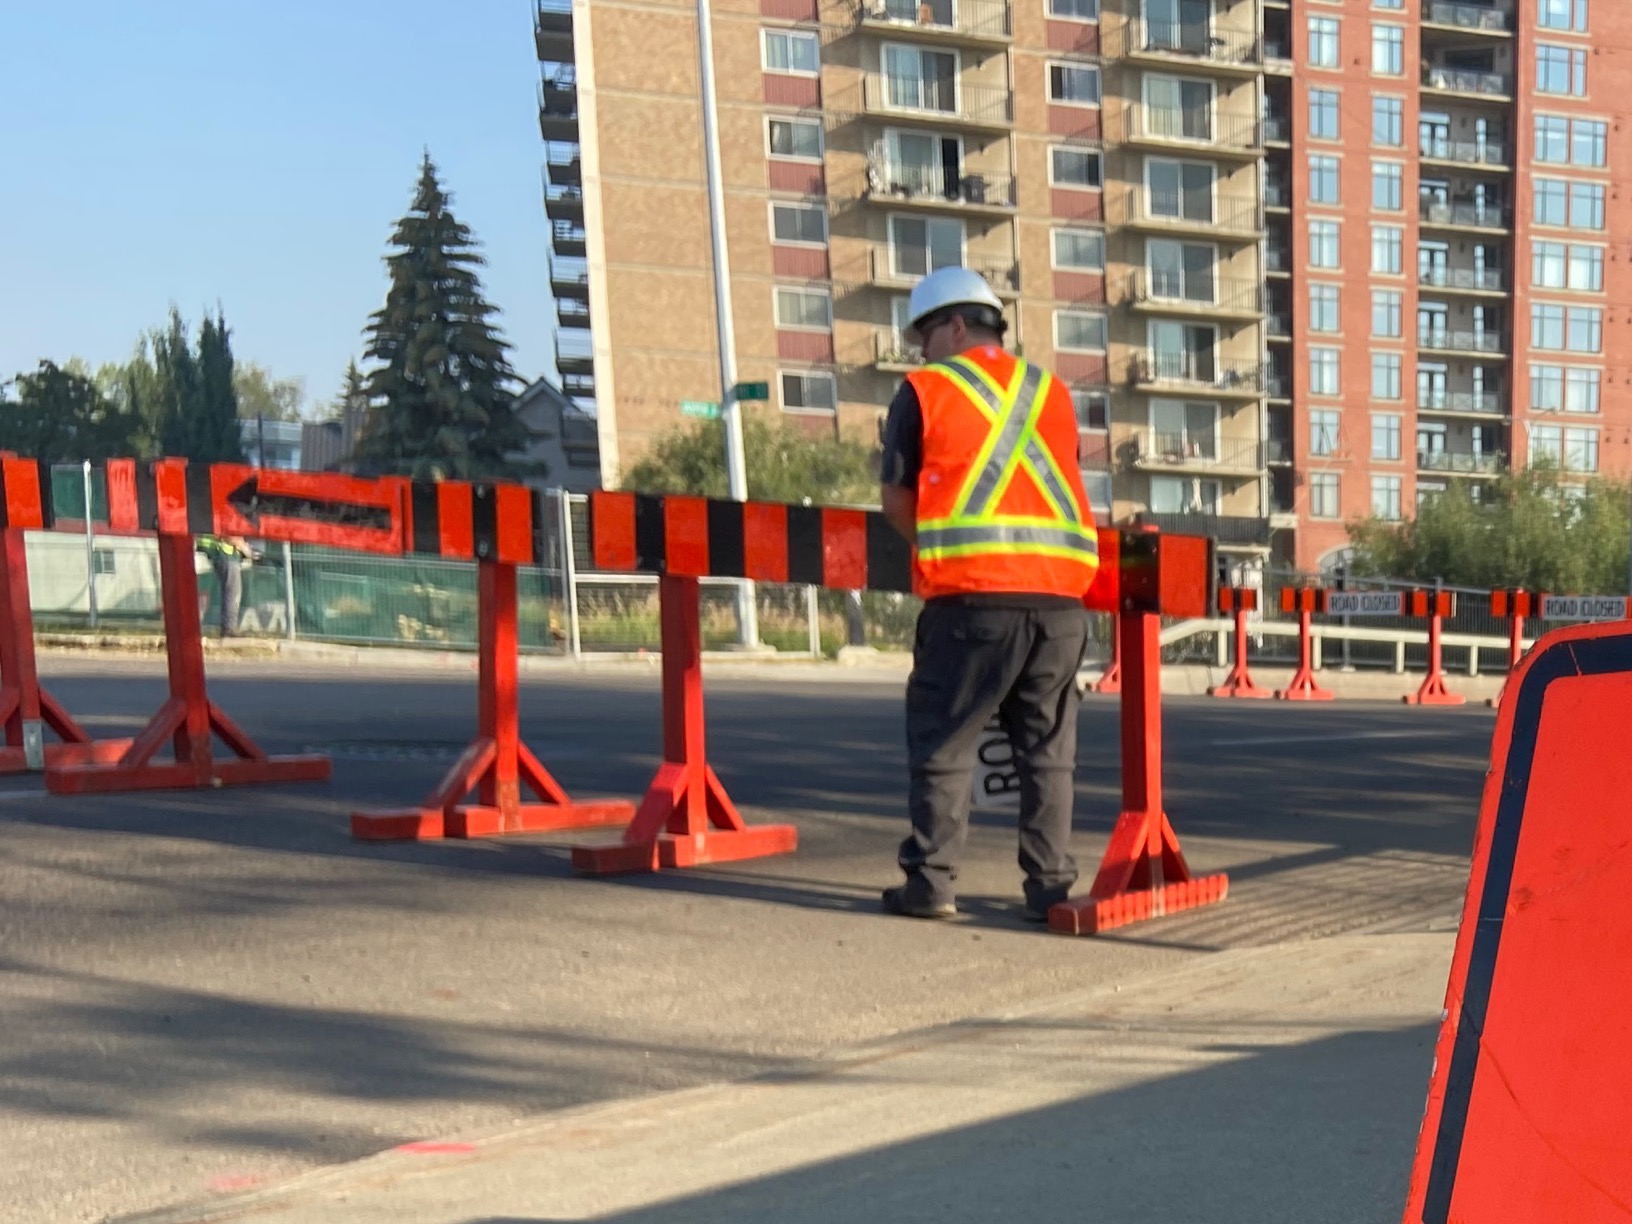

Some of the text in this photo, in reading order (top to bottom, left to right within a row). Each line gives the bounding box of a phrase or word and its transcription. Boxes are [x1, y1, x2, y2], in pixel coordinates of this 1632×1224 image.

[1331, 595, 1398, 612] ROAD CLOSED
[1546, 600, 1625, 617] ROAD CLOSED
